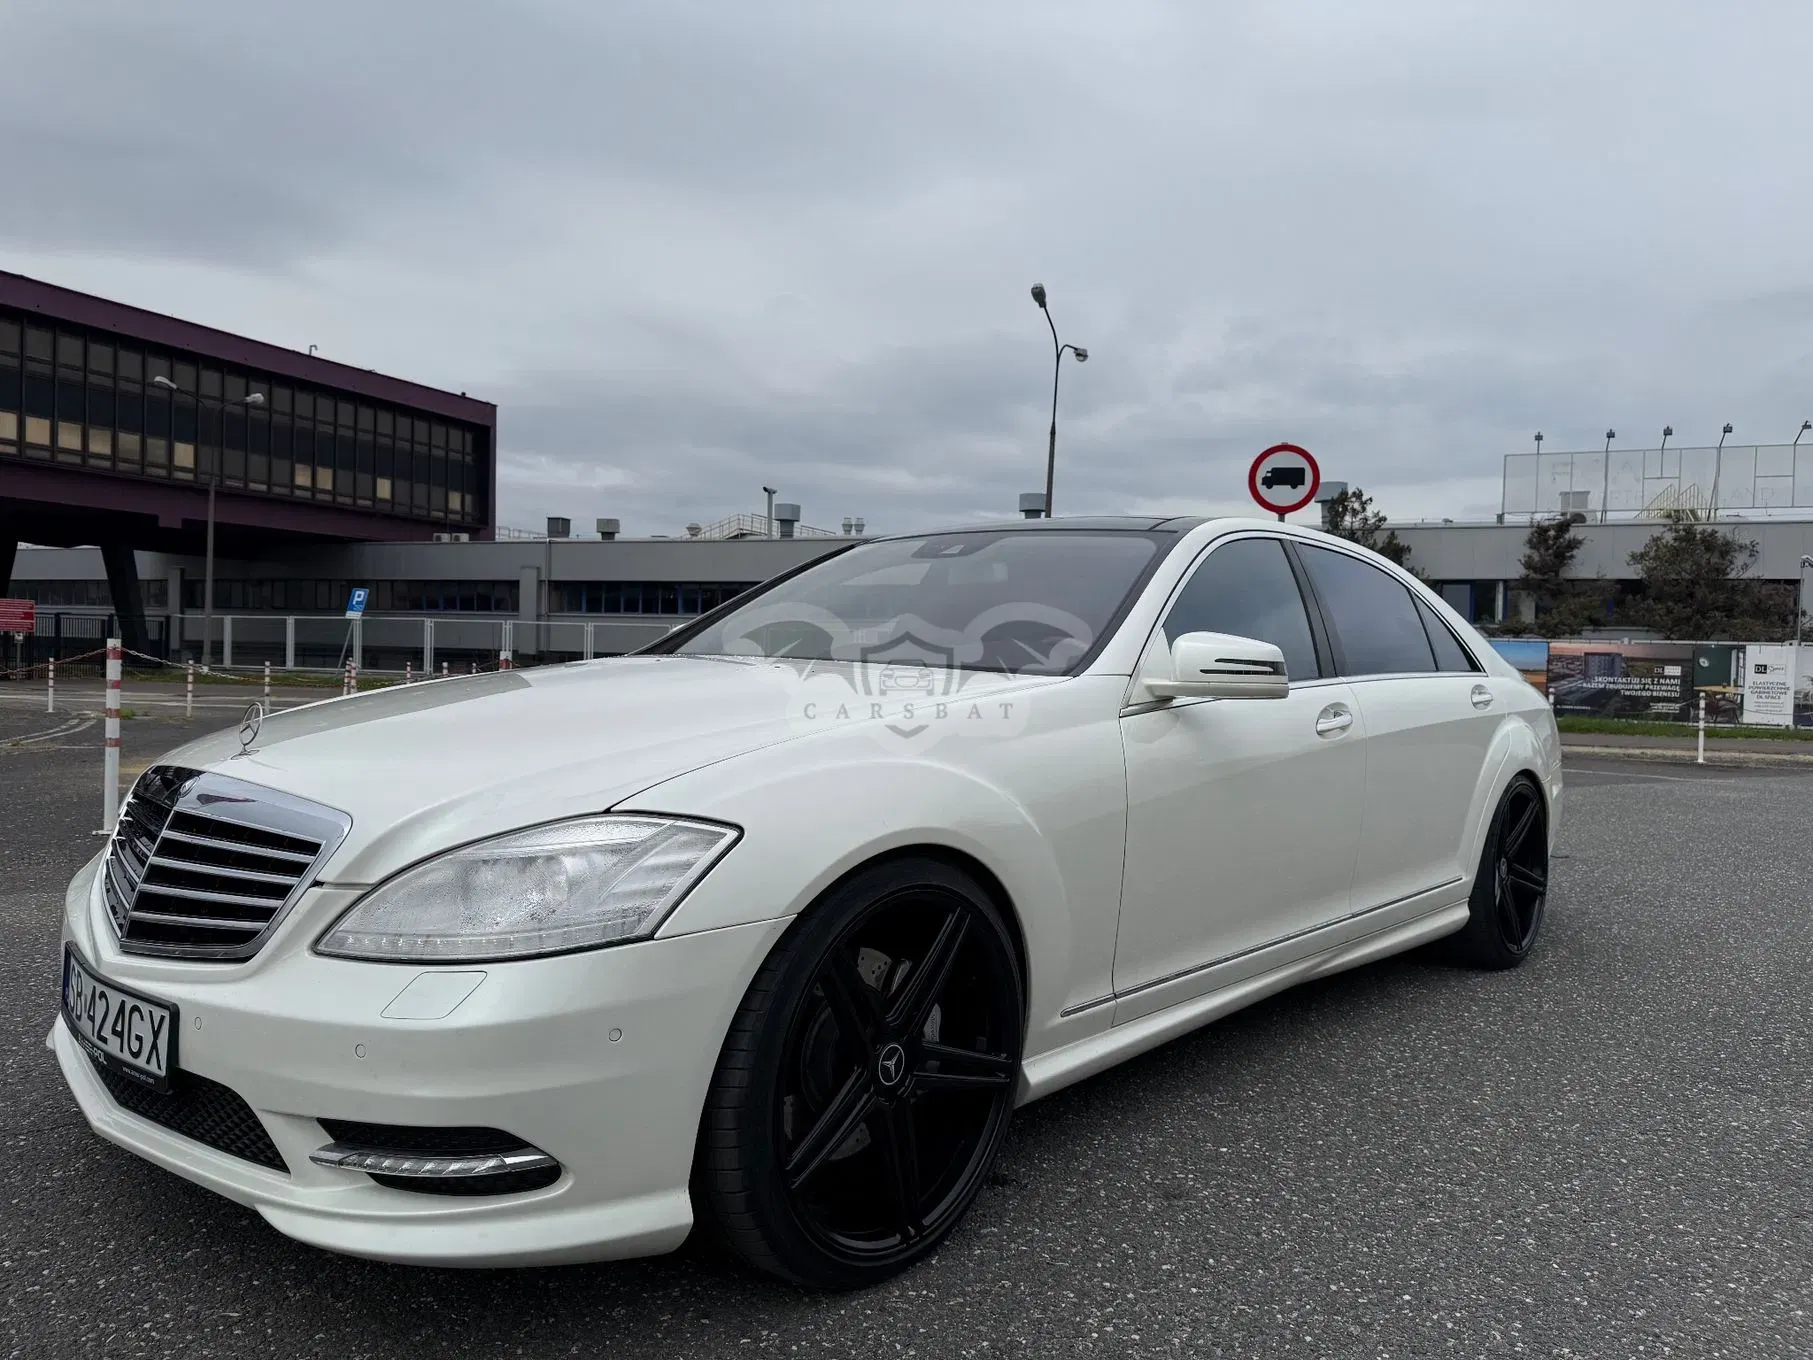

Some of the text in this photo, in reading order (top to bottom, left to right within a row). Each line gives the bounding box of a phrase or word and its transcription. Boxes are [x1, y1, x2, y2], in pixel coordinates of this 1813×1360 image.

[353, 590, 365, 605] P
[1755, 665, 1767, 673] DL
[1594, 676, 1640, 684] SKONTAKTUJ
[1641, 677, 1652, 685] SIĘ
[70, 964, 166, 1071] SB 424GX
